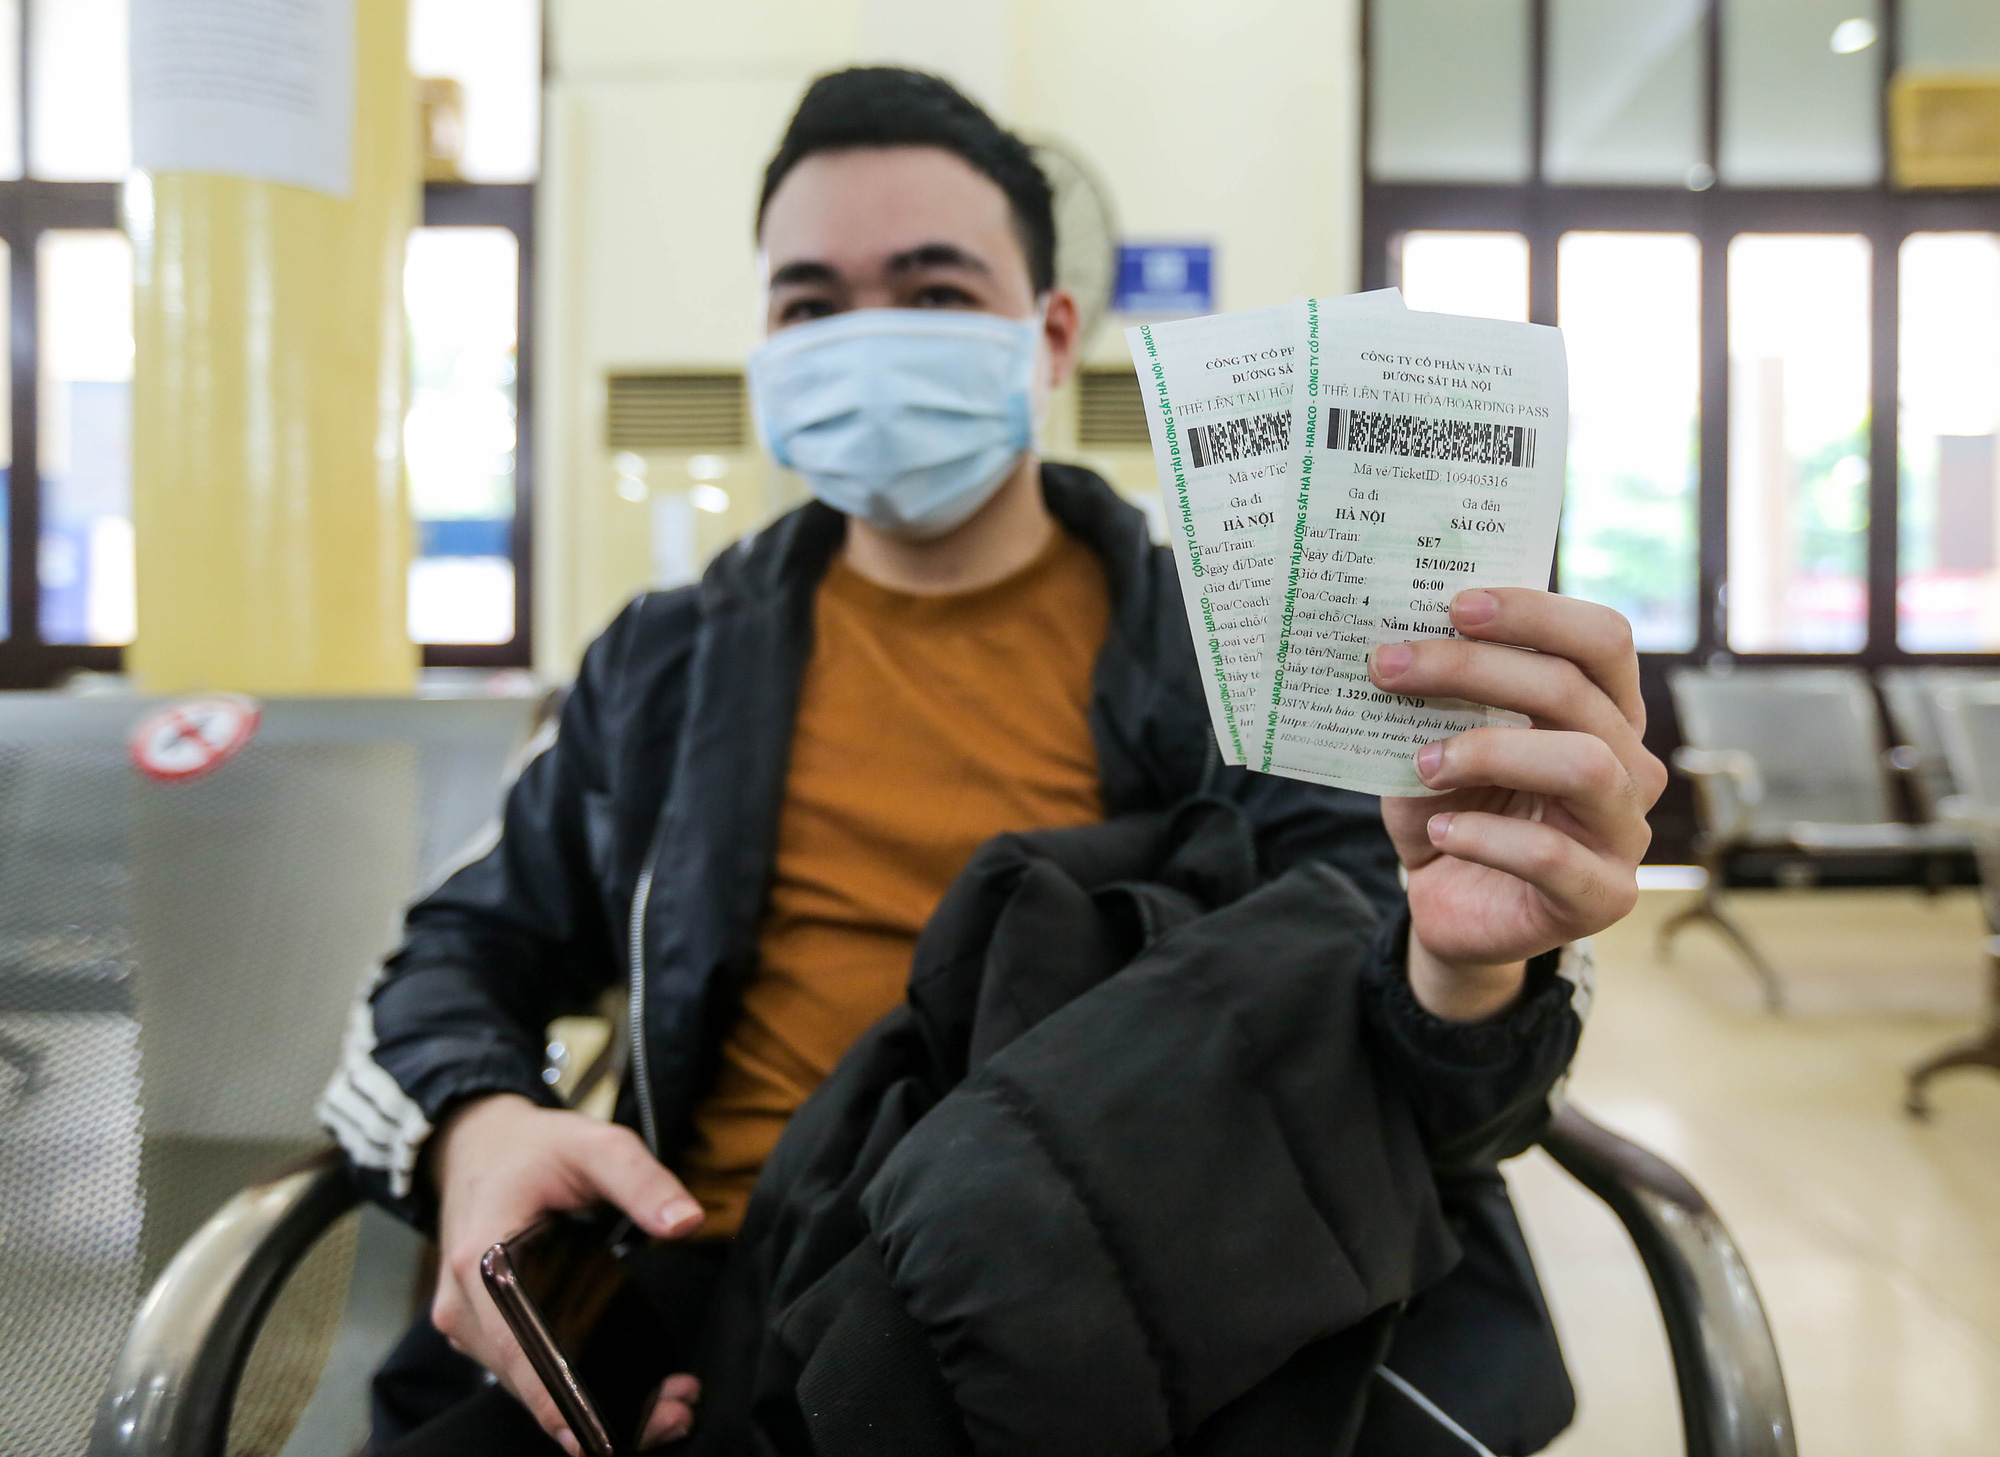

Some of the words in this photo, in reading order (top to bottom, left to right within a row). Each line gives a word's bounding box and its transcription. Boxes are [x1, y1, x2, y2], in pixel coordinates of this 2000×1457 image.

[1140, 324, 1159, 358] HARACO
[1205, 356, 1240, 370] CÔNG
[1242, 353, 1258, 364] TY
[1281, 346, 1294, 356] PH
[1310, 355, 1319, 367] TY
[1360, 352, 1394, 364] CÔNG
[1397, 356, 1412, 366] TY
[1434, 358, 1466, 372] PHẦN
[1468, 362, 1492, 376] VẬN
[1494, 364, 1512, 377] TẢI
[1152, 364, 1165, 380] NỘI
[1232, 367, 1276, 384] ĐƯỜNG
[1278, 362, 1294, 375] SẮ
[1308, 368, 1319, 397] CÔNG
[1382, 370, 1424, 384] ĐƯỜNG
[1428, 373, 1449, 386] SẮT
[1452, 376, 1468, 389] HÀ
[1470, 378, 1492, 392] NỘI
[1156, 380, 1169, 395] HÀ
[1158, 397, 1172, 416] SẮT
[1176, 400, 1204, 416] THẺ
[1207, 395, 1234, 411] LÊN
[1237, 390, 1266, 405] TÀU
[1322, 383, 1348, 397] THẺ
[1353, 384, 1379, 400] LÊN
[1382, 388, 1410, 403] TÀU
[1414, 391, 1514, 415] HỎA/BOARDING
[1518, 404, 1550, 418] PASS
[1306, 406, 1317, 448] HARACO
[1163, 417, 1180, 459] ĐƯỜNG
[1170, 456, 1183, 472] TẢI
[1228, 471, 1248, 484] Mã
[1251, 462, 1288, 479] vé/Tic
[1302, 456, 1316, 474] NỘI
[1174, 473, 1189, 494] VẬN
[1300, 476, 1311, 490] HÀ
[1354, 462, 1372, 476] Mã
[1376, 467, 1442, 482] vé/TicketID:
[1446, 471, 1508, 488] 109405316
[1230, 496, 1248, 508] Ga
[1250, 493, 1262, 505] đi
[1297, 492, 1309, 510] SẮT
[1348, 488, 1365, 500] Ga
[1368, 488, 1380, 502] đi
[1462, 498, 1478, 510] Ga
[1481, 498, 1501, 512] đến
[1223, 516, 1244, 532] HÀ
[1248, 512, 1276, 528] NỘI
[1336, 506, 1358, 521] HÀ
[1360, 510, 1386, 524] NỘI
[1294, 512, 1307, 550] ĐƯỜNG
[1303, 525, 1361, 542] Tàu/Train:
[1417, 536, 1442, 548] SE7
[1450, 518, 1473, 532] SÀI
[1476, 520, 1506, 534] GÒN
[1188, 540, 1198, 551] TY
[1198, 538, 1256, 556] Tàu/Train:
[1190, 552, 1204, 578] CÔNG
[1200, 562, 1229, 577] Ngày
[1300, 547, 1328, 566] Ngày
[1332, 550, 1376, 565] đi/Date:
[1415, 558, 1476, 573] 15/10/2021
[1204, 582, 1225, 594] Giờ
[1297, 567, 1318, 580] Giờ
[1321, 570, 1368, 585] đi/Time:
[1412, 579, 1444, 592] 06:00
[1294, 587, 1358, 606] Toa/Coach:
[1362, 596, 1370, 606] 4
[1410, 598, 1450, 613] Chỗ/Se
[1200, 598, 1216, 632] HARACO
[1290, 608, 1316, 620] Loại
[1319, 610, 1376, 628] chỗ/Class:
[1412, 622, 1456, 638] khoang
[1280, 628, 1290, 638] TY
[1288, 626, 1313, 638] Loại
[1316, 628, 1370, 644] vé/Ticket:
[1277, 640, 1289, 664] CÔNG
[1285, 644, 1302, 656] Họ
[1305, 646, 1361, 662] tên/Name:
[1282, 660, 1308, 675] Giấy
[1311, 666, 1371, 683] tờ/Passpor
[1272, 670, 1284, 704] HARACO
[1280, 679, 1333, 696] Giá/Price:
[1336, 687, 1392, 704] 1.329.000
[1268, 710, 1280, 726] NỘI
[1310, 702, 1333, 715] kính
[1335, 704, 1358, 718] báo:
[1360, 709, 1383, 723] Quý
[1384, 712, 1416, 727] khách
[1416, 714, 1442, 730] phải
[1444, 720, 1468, 732] khai
[1266, 728, 1276, 740] HÀ
[1382, 729, 1410, 744] trước
[1412, 732, 1430, 746] khi
